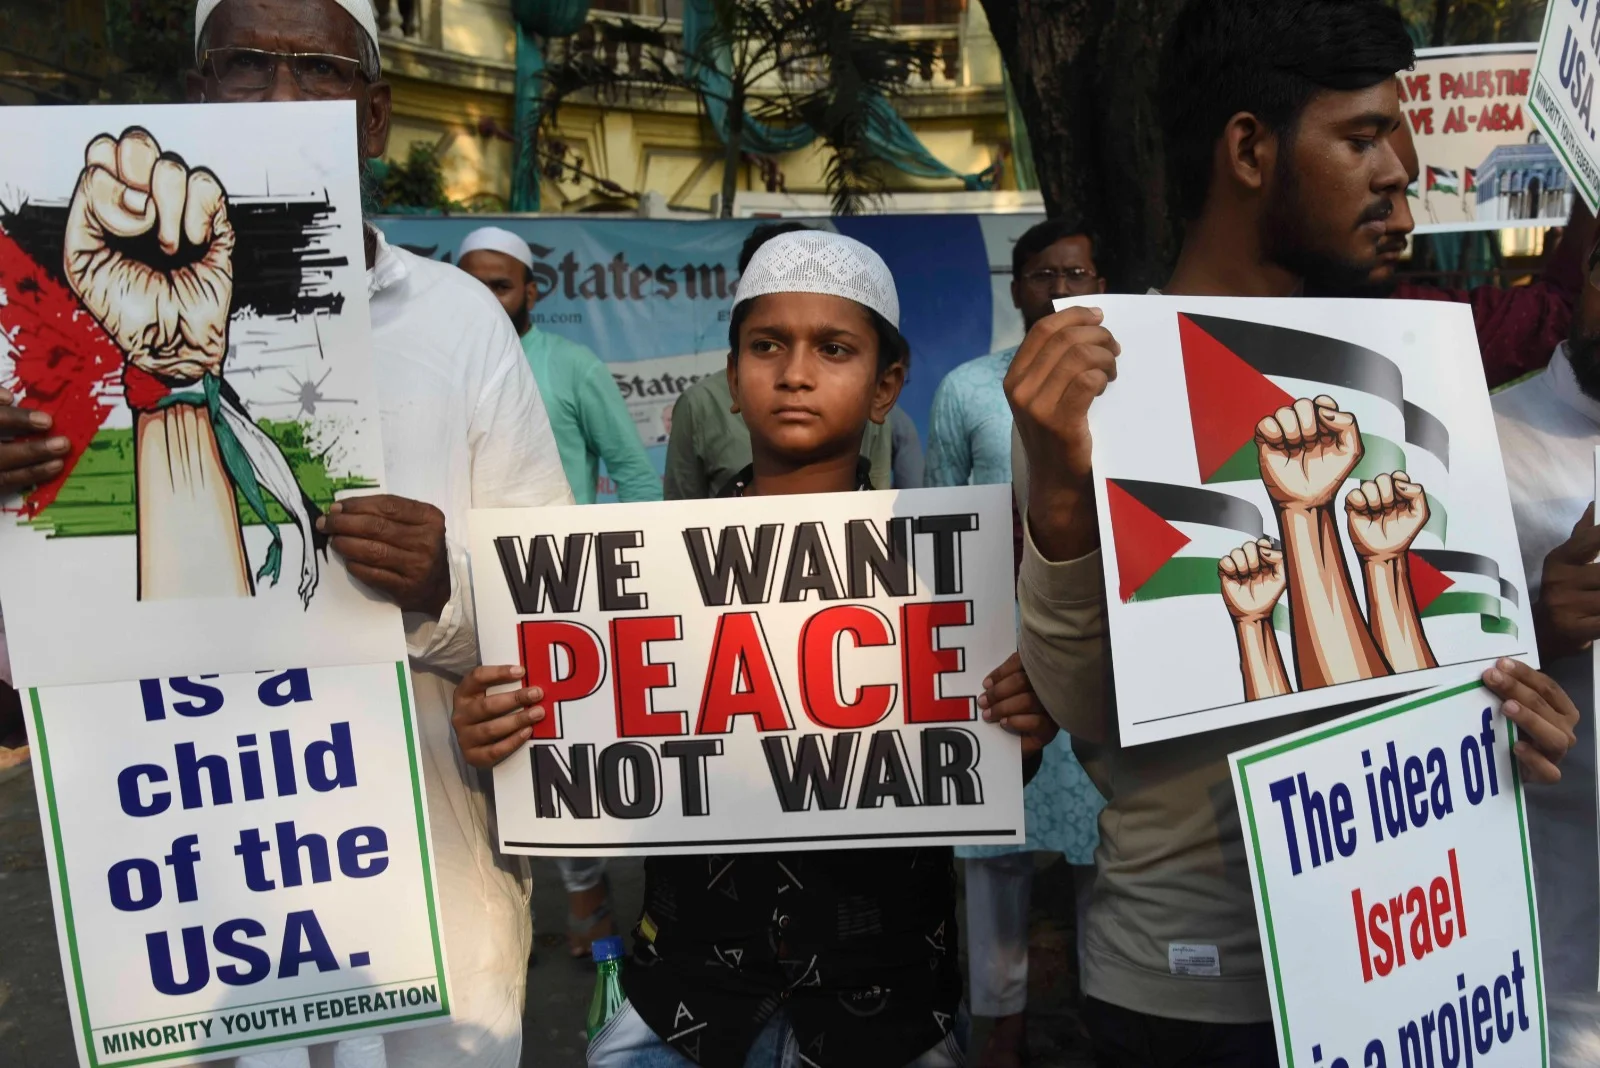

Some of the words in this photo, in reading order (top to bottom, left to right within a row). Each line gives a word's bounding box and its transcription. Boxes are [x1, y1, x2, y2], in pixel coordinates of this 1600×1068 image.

[1401, 107, 1434, 135] VE
[1442, 103, 1525, 134] AL-AQSA
[1440, 68, 1531, 100] PALESTINE
[1535, 80, 1562, 129] MINORITY
[1560, 118, 1576, 156] YOUTH
[1559, 25, 1596, 141] USA.
[494, 530, 648, 614] WE
[682, 513, 979, 607] WANT
[516, 600, 977, 741] PEACE
[117, 721, 358, 818] child
[530, 738, 723, 819] NOT
[761, 728, 984, 812] WAR
[1269, 772, 1357, 876] The
[1361, 741, 1453, 843] idea
[1460, 707, 1499, 806] of
[107, 834, 201, 912] of
[234, 821, 390, 892] the
[145, 909, 371, 996] USA.
[1351, 848, 1467, 984] Israel
[102, 1019, 214, 1055] MINORITY
[220, 1004, 298, 1034] YOUTH
[302, 984, 438, 1022] FEDERATION
